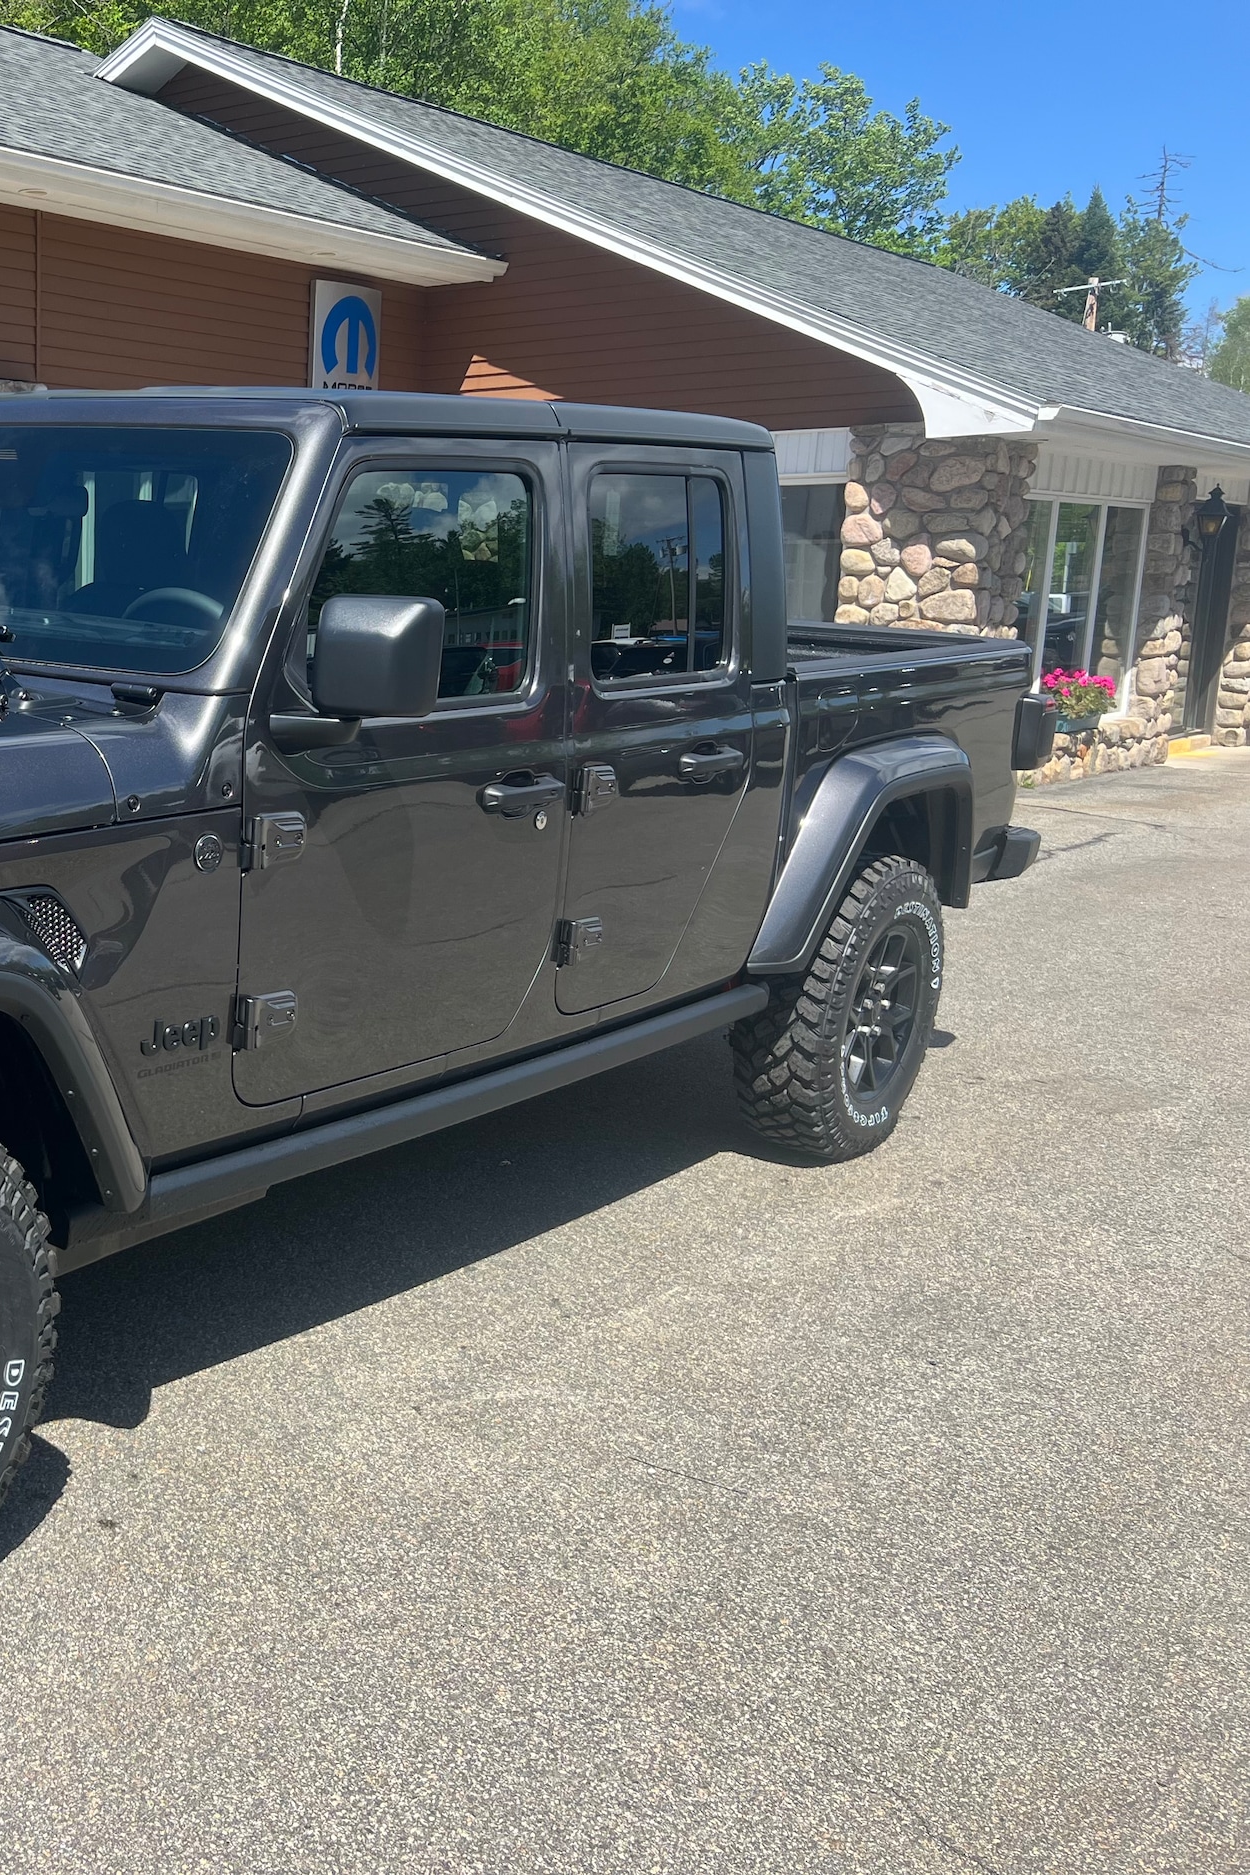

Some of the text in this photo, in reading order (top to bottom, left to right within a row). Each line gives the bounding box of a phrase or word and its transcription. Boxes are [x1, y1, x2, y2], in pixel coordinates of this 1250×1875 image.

[893, 901, 941, 974] DESTINATION
[140, 1014, 221, 1057] Jeep
[137, 1054, 209, 1079] GLADIATOR
